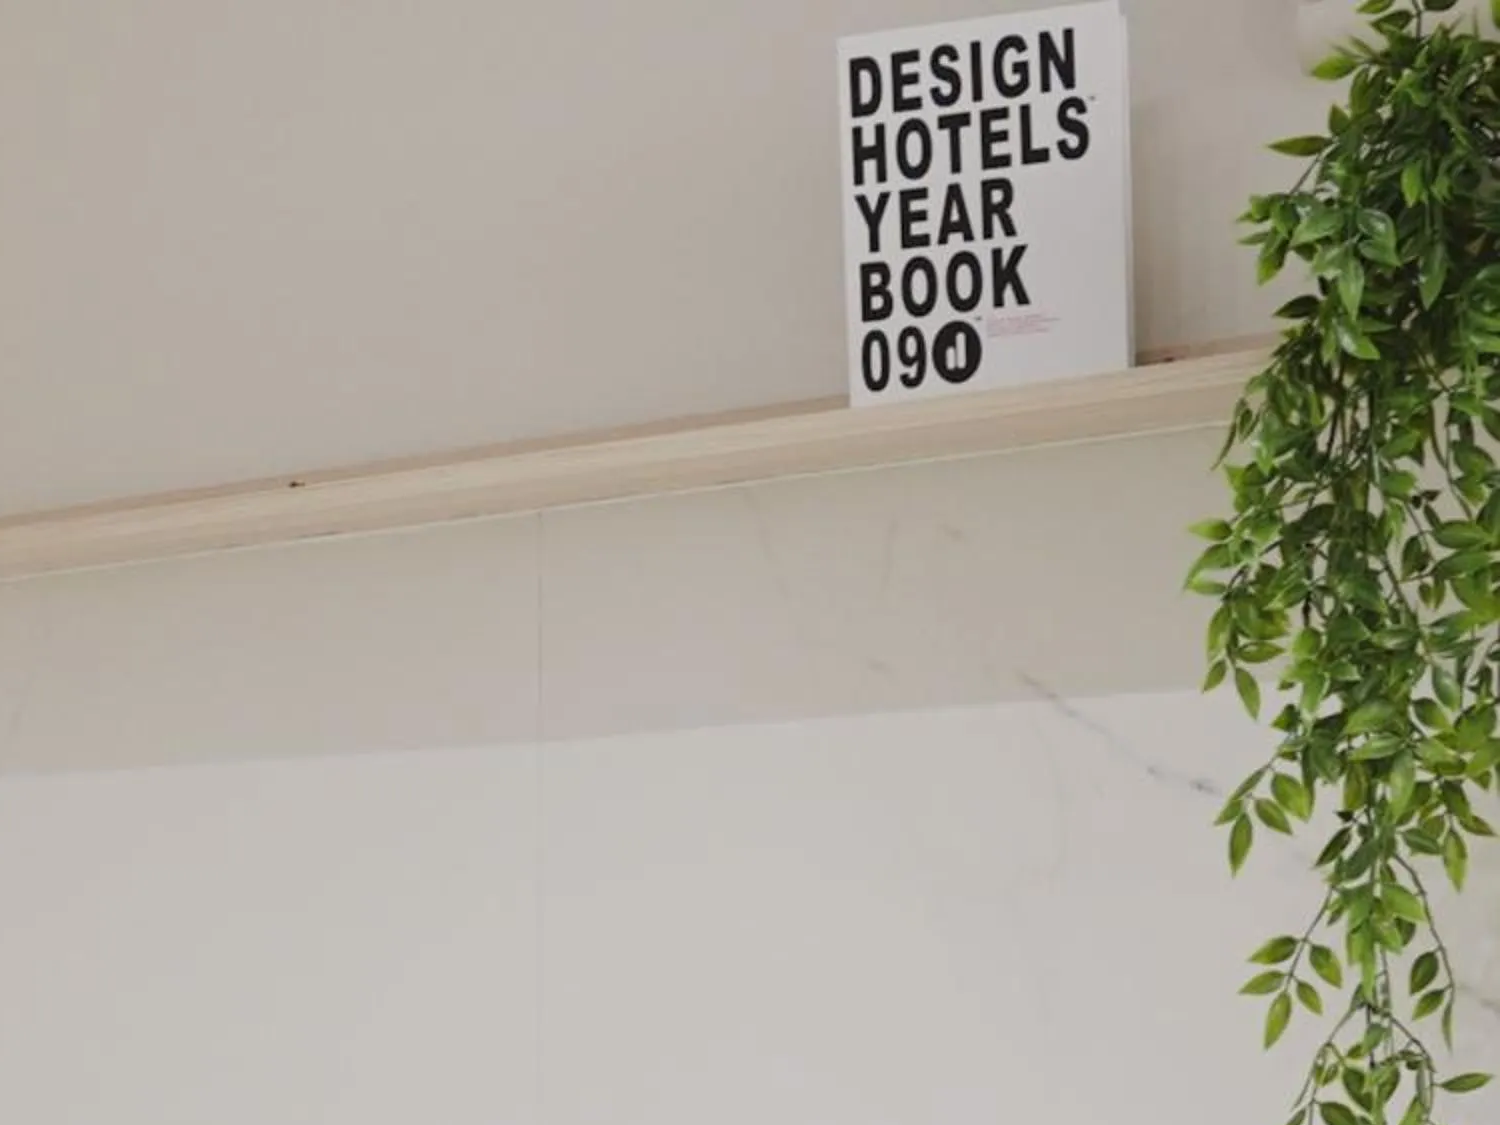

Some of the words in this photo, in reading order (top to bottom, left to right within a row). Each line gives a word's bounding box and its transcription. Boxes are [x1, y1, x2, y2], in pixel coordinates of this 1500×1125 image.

[849, 28, 1076, 118] DESIGN
[852, 97, 1090, 186] HOTELS
[854, 178, 1017, 253] YEAR
[860, 245, 1031, 323] BOOK
